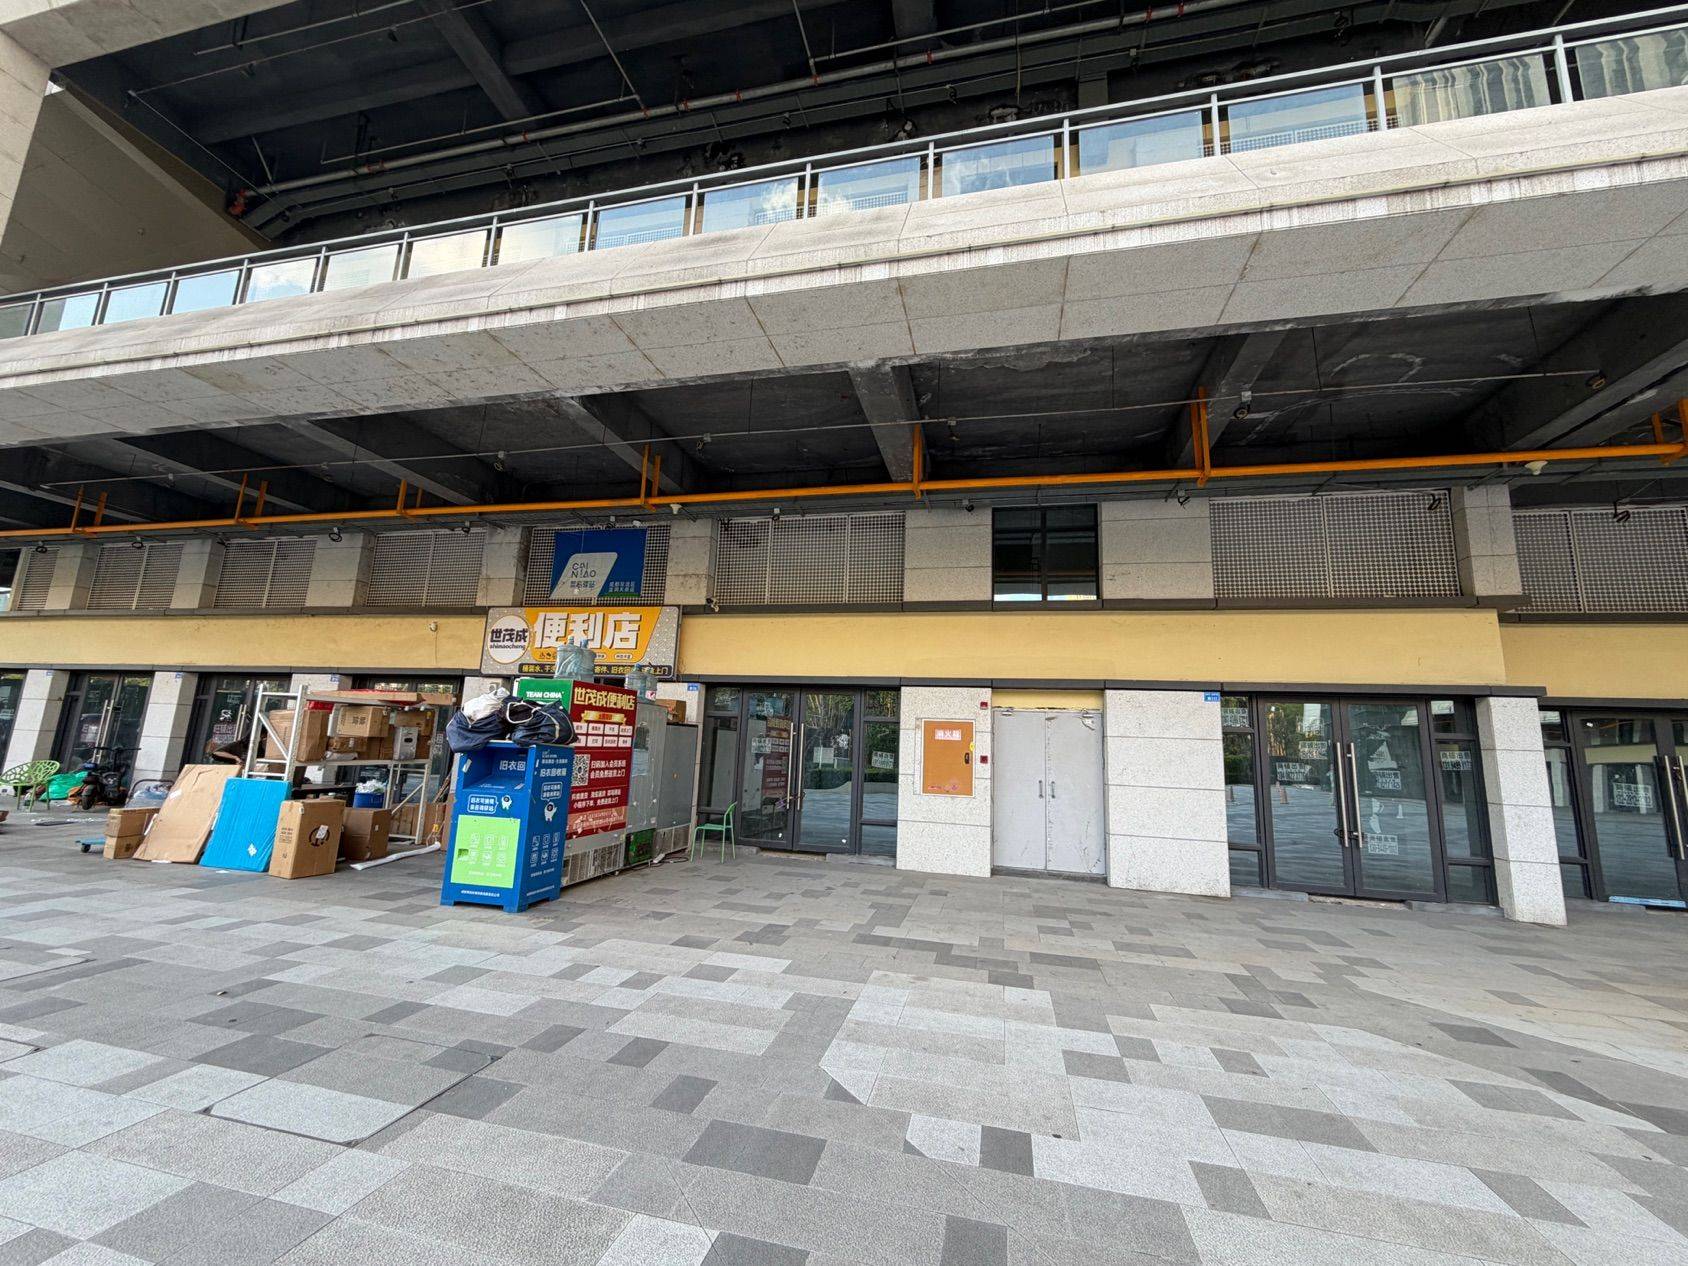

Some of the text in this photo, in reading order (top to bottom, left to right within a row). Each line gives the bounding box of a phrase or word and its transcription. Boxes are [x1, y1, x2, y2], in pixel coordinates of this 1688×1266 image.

[490, 628, 528, 643] 世茂成
[534, 612, 641, 649] 便利店
[573, 686, 636, 710] 世茂成便利店
